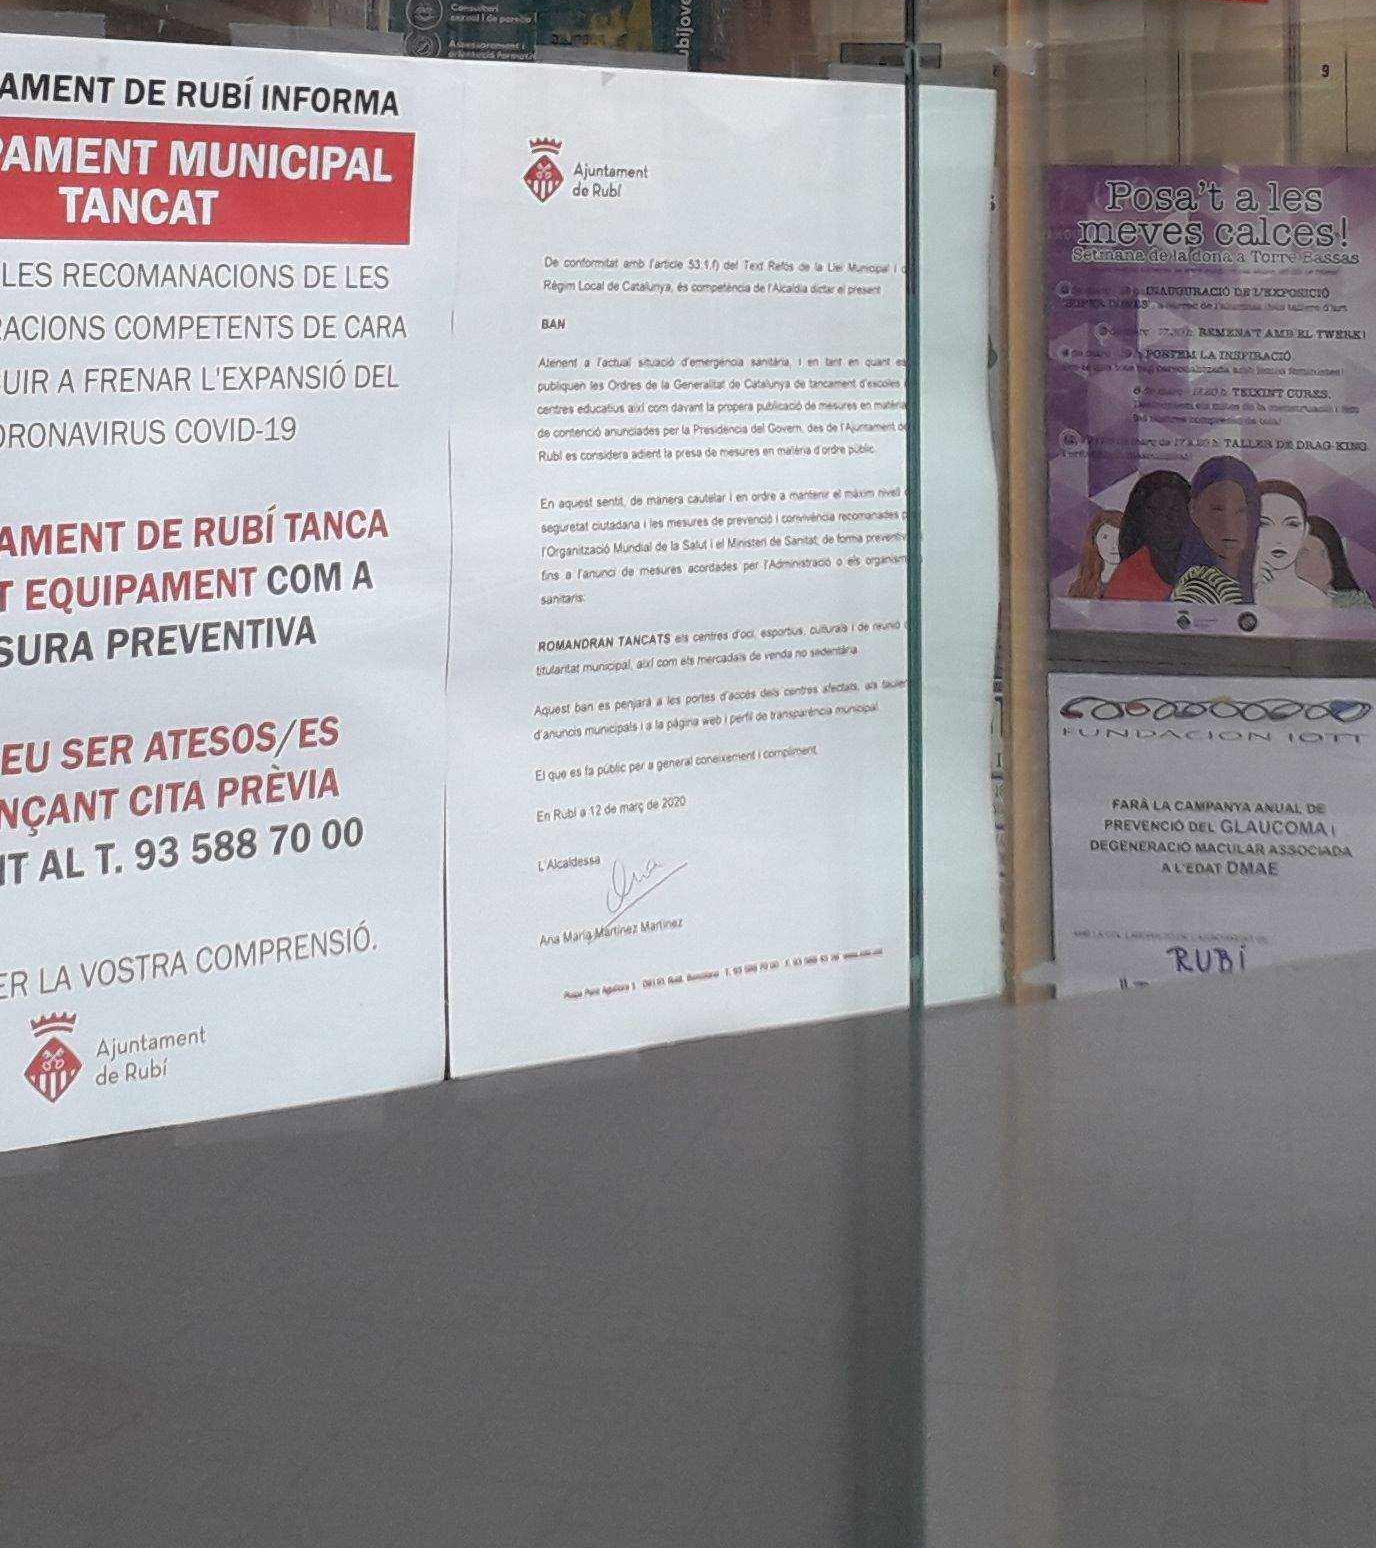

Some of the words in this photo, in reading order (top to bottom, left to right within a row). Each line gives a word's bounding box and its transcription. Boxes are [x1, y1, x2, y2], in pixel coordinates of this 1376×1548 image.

[124, 77, 166, 106] DE
[176, 75, 253, 109] RUBÍ
[261, 84, 398, 116] INFORMA
[168, 140, 392, 182] MUNICIPAL
[572, 161, 648, 182] Ajuntament
[572, 182, 589, 197] de
[592, 182, 622, 197] Rubí
[1106, 180, 1224, 212] Posa't
[1235, 188, 1259, 212] a
[1269, 181, 1324, 212] les
[58, 186, 219, 225] TANCAT
[1078, 220, 1202, 246] meves
[1215, 217, 1352, 247] calces!
[2, 261, 52, 287] LES
[63, 262, 294, 288] RECOMANACIONS
[303, 264, 336, 288] DE
[345, 265, 389, 289] LES
[114, 314, 293, 340] COMPETENTS
[303, 314, 336, 338] DE
[344, 314, 406, 338] CARA
[541, 318, 565, 329] BAN
[57, 368, 74, 393] A
[84, 366, 191, 393] FRENAR
[202, 358, 346, 391] L'EXPANSIÓ
[354, 364, 399, 388] DEL
[175, 416, 296, 443] COVID-19
[137, 518, 182, 550] DE
[193, 506, 276, 547] RUBÍ
[283, 508, 388, 542] TANCA
[25, 566, 257, 614] EQUIPAMENT
[266, 561, 341, 595] COM
[352, 560, 373, 590] A
[106, 615, 316, 659] PREVENTIVA
[537, 636, 613, 652] ROMANDRAN
[617, 632, 670, 647] TANCATS
[693, 630, 729, 643] centres
[60, 734, 133, 770] SER
[143, 715, 338, 762] ATESOS/ES
[128, 779, 205, 816] CITA
[217, 765, 339, 808] PRÈVIA
[536, 810, 550, 822] En
[553, 806, 576, 821] Rubí
[579, 808, 586, 818] a
[588, 803, 601, 816] 12
[603, 802, 617, 815] de
[619, 801, 644, 814] març
[646, 798, 659, 810] de
[661, 794, 686, 809] 2020
[1111, 797, 1149, 811] FARÀ
[1152, 799, 1171, 812] LA
[1173, 799, 1251, 812] CAMPANYA
[1254, 802, 1301, 814] ANUAL
[1306, 803, 1324, 814] DE
[1104, 817, 1184, 833] PREVENCIÓ
[1188, 820, 1215, 833] DEL
[1219, 818, 1328, 836] GLAUCOMA
[38, 846, 84, 881] AL
[94, 842, 122, 875] T.
[134, 835, 178, 870] 93
[191, 827, 256, 864] 588
[269, 822, 310, 855] 70
[321, 816, 363, 850] 00
[1089, 839, 1191, 853] DEGENERACIÓ
[1195, 842, 1265, 856] MACULAR
[1268, 844, 1353, 858] ASSOCIADA
[537, 855, 600, 872] L'Alcaldessa
[1160, 862, 1171, 873] A
[1174, 862, 1222, 875] L'EDAT
[1225, 860, 1278, 877] DMAE
[39, 965, 71, 994] LA
[79, 949, 187, 988] VOSTRA
[195, 918, 377, 974] COMPRENSIÓ.
[95, 1025, 206, 1060] Ajuntament
[95, 1063, 119, 1086] de
[125, 1057, 167, 1082] Rubí
